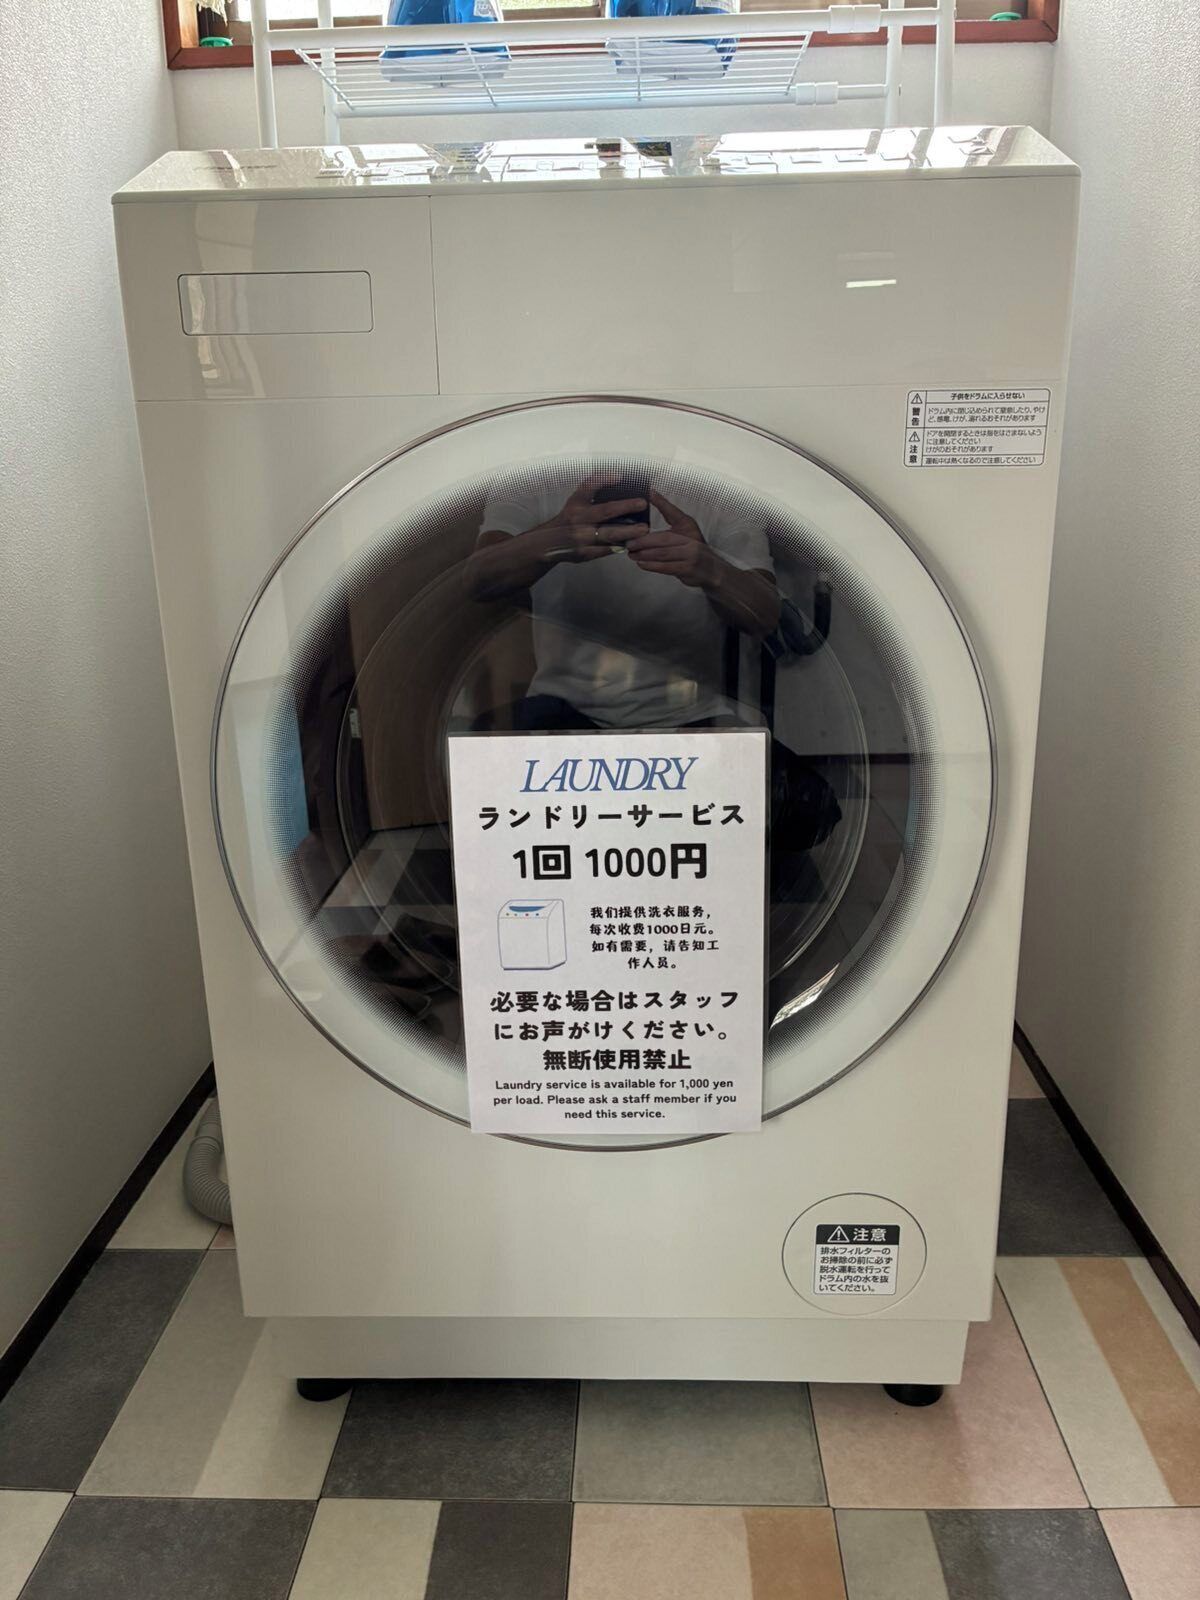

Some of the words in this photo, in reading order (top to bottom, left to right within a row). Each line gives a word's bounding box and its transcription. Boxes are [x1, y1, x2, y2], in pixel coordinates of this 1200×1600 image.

[951, 392, 1025, 401] 子供をドラムに入らせない
[911, 406, 921, 426] 警告
[909, 445, 918, 464] 注意
[519, 756, 699, 793] LAUNDRY
[479, 802, 744, 831] ランドリーサービス
[512, 845, 571, 880] 1回
[585, 843, 707, 879] 1000円
[590, 905, 711, 919] 我们提供洗衣服务，
[589, 922, 716, 936] 每次收费1000日元。
[627, 956, 678, 969] 作人员。
[490, 989, 738, 1013] 必要な場合はスタッフ
[494, 1020, 727, 1042] にお声がけください。
[542, 1049, 692, 1071] 無断使用禁止
[495, 1080, 542, 1092] Laundry
[546, 1080, 587, 1089] service
[591, 1080, 600, 1089] is
[604, 1079, 656, 1089] available
[659, 1079, 677, 1088] for
[679, 1079, 710, 1090] 1,000
[713, 1080, 734, 1090] yen
[493, 1097, 512, 1106] per
[516, 1095, 543, 1104] load.
[547, 1095, 585, 1104] Please
[588, 1095, 608, 1104] ask
[622, 1094, 651, 1104] staff
[654, 1094, 701, 1103] member
[704, 1094, 713, 1103] if
[716, 1095, 737, 1105] you
[564, 1110, 592, 1119] need
[596, 1109, 618, 1118] this
[621, 1109, 666, 1118] service.
[852, 1227, 887, 1242] 注意
[820, 1246, 891, 1255] 排水フィルターの
[820, 1256, 893, 1265] お掃除の前に必ず
[819, 1265, 891, 1274] 脱水運転を行って
[819, 1274, 889, 1283] ドラム内の水を抜
[818, 1284, 876, 1292] いてください。
